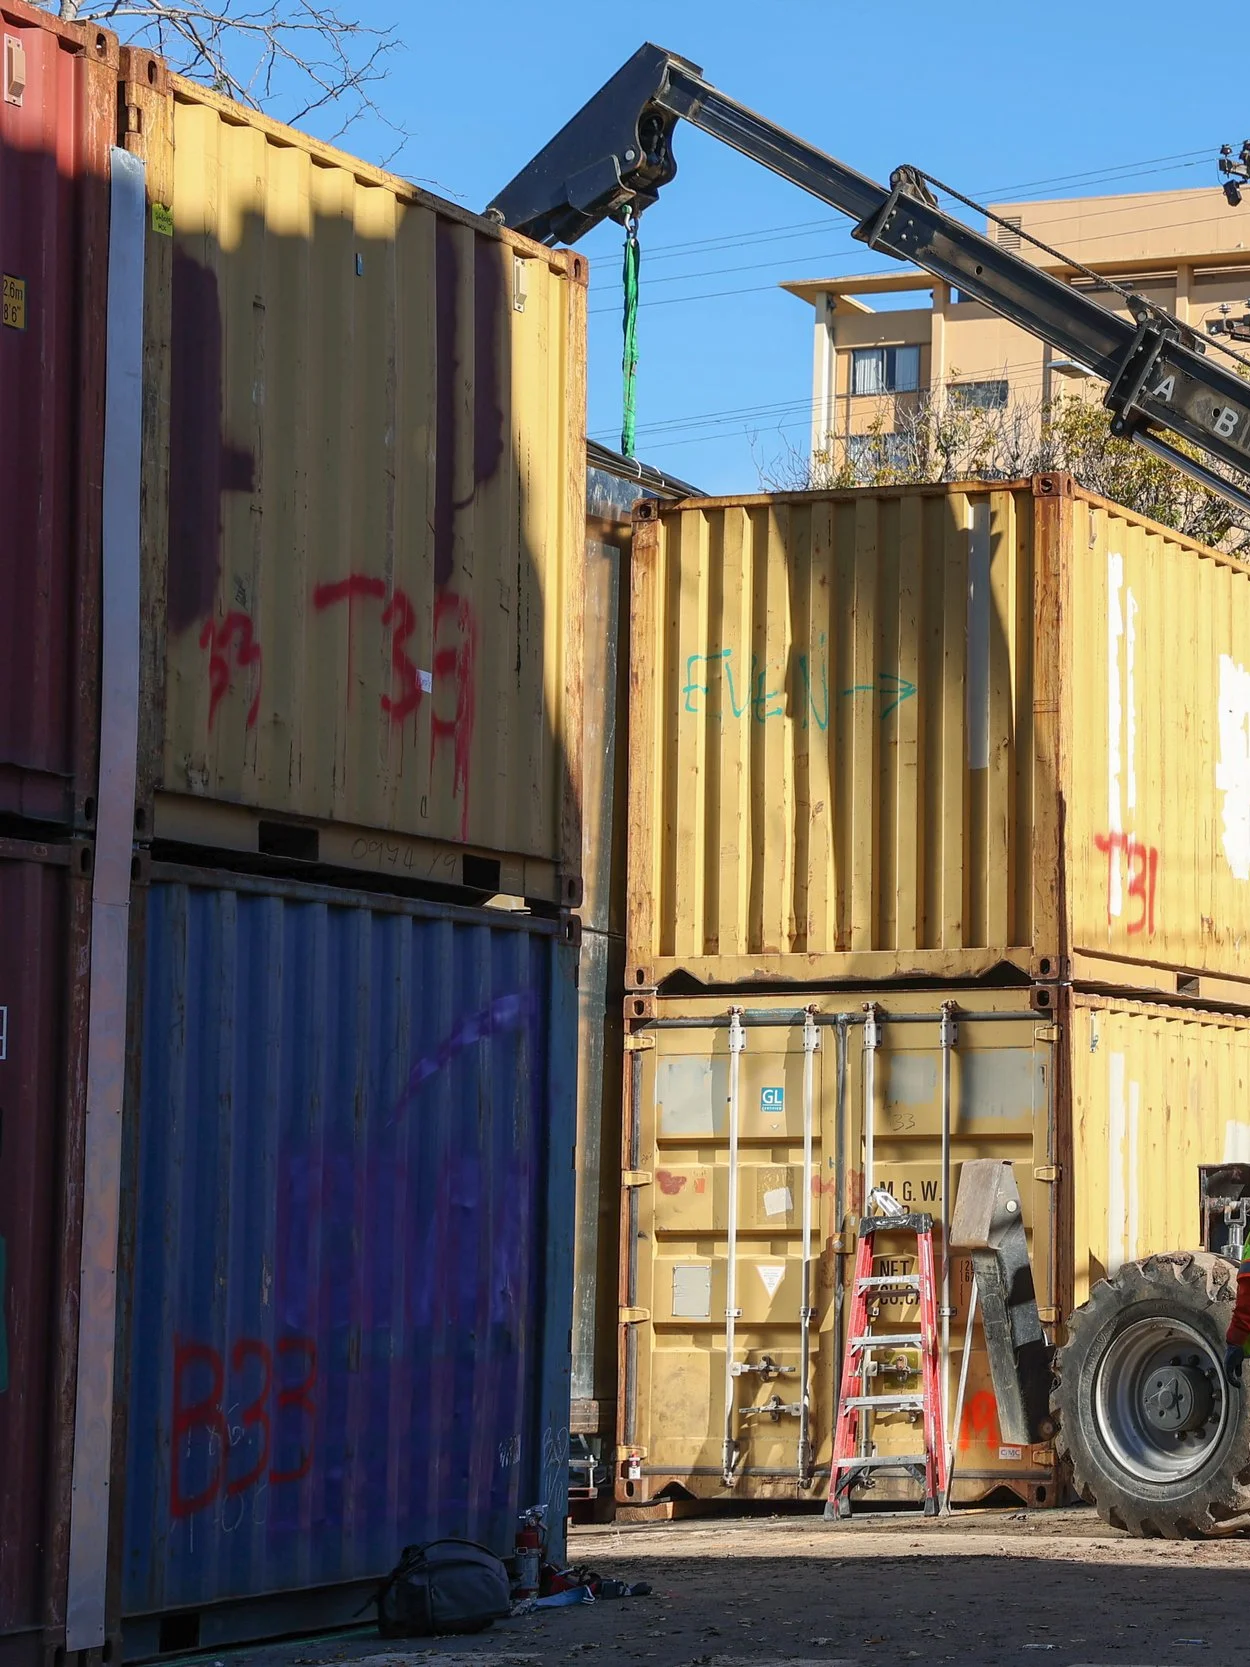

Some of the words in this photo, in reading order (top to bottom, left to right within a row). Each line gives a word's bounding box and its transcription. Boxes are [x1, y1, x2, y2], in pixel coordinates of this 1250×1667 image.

[1153, 375, 1175, 401] A
[1213, 406, 1238, 438] B
[762, 1089, 782, 1104] GL
